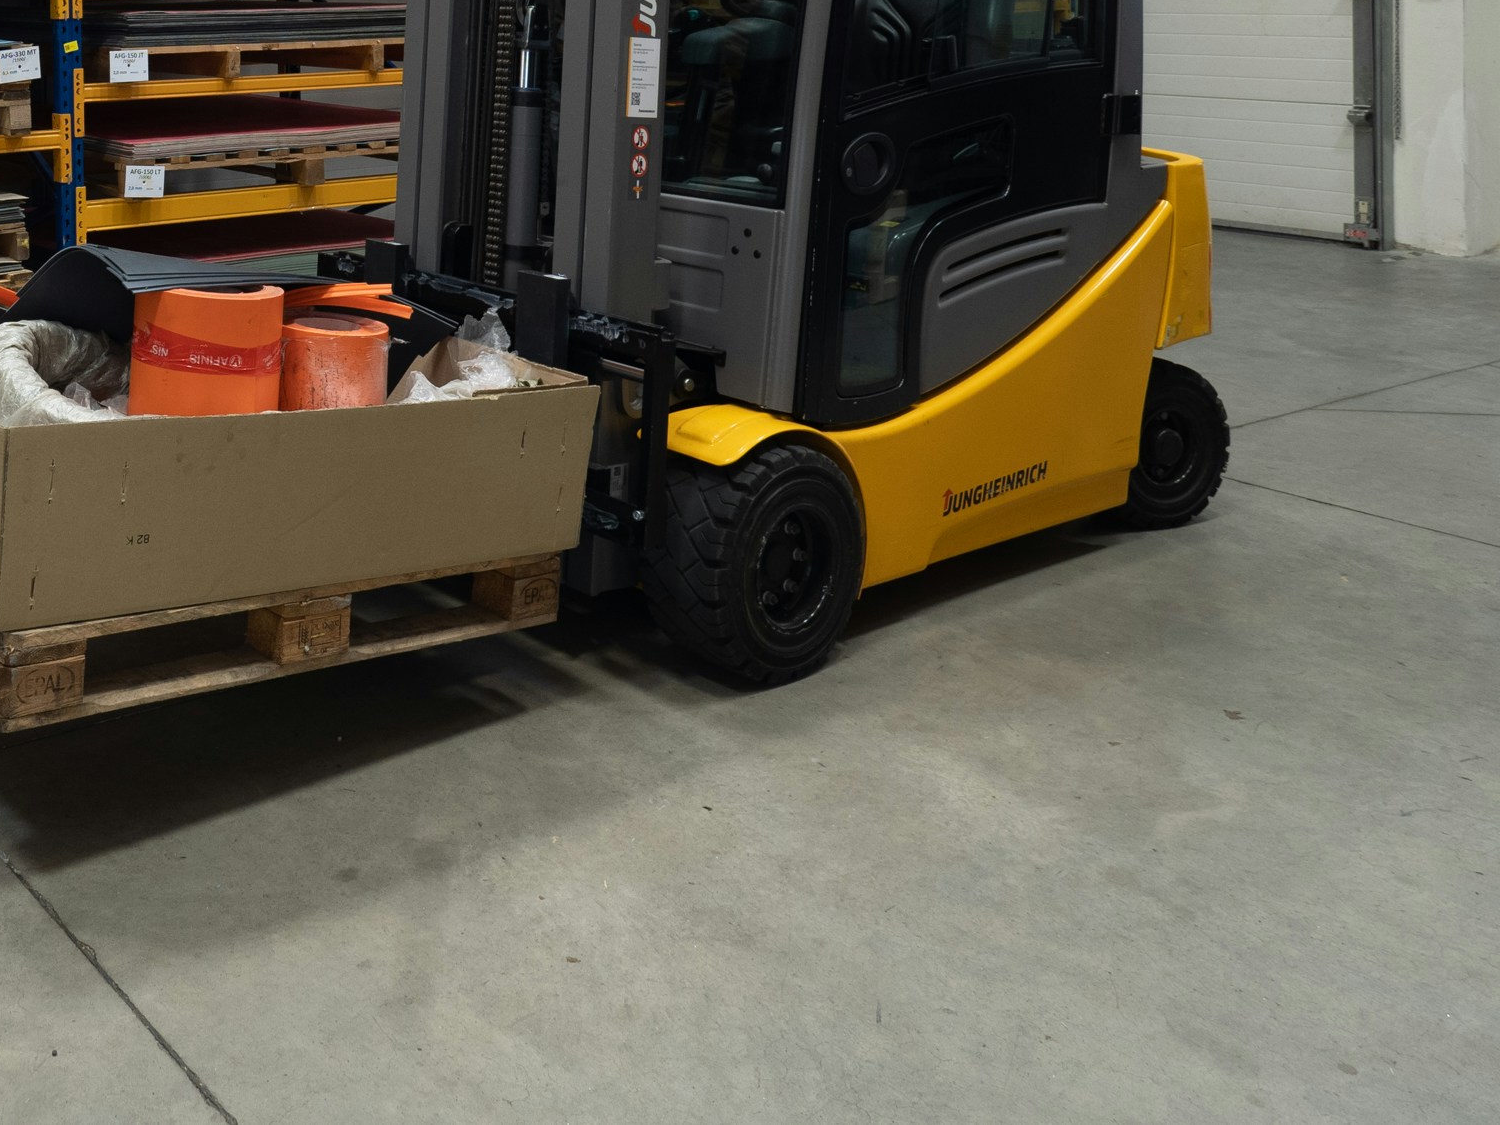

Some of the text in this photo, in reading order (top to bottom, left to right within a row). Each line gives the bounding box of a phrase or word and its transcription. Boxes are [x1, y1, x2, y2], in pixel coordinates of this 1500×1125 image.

[0, 51, 25, 60] AFG-330
[190, 354, 229, 366] AFINIS
[943, 460, 1047, 517] JUNGHEINRICH
[126, 534, 150, 546] 82 K
